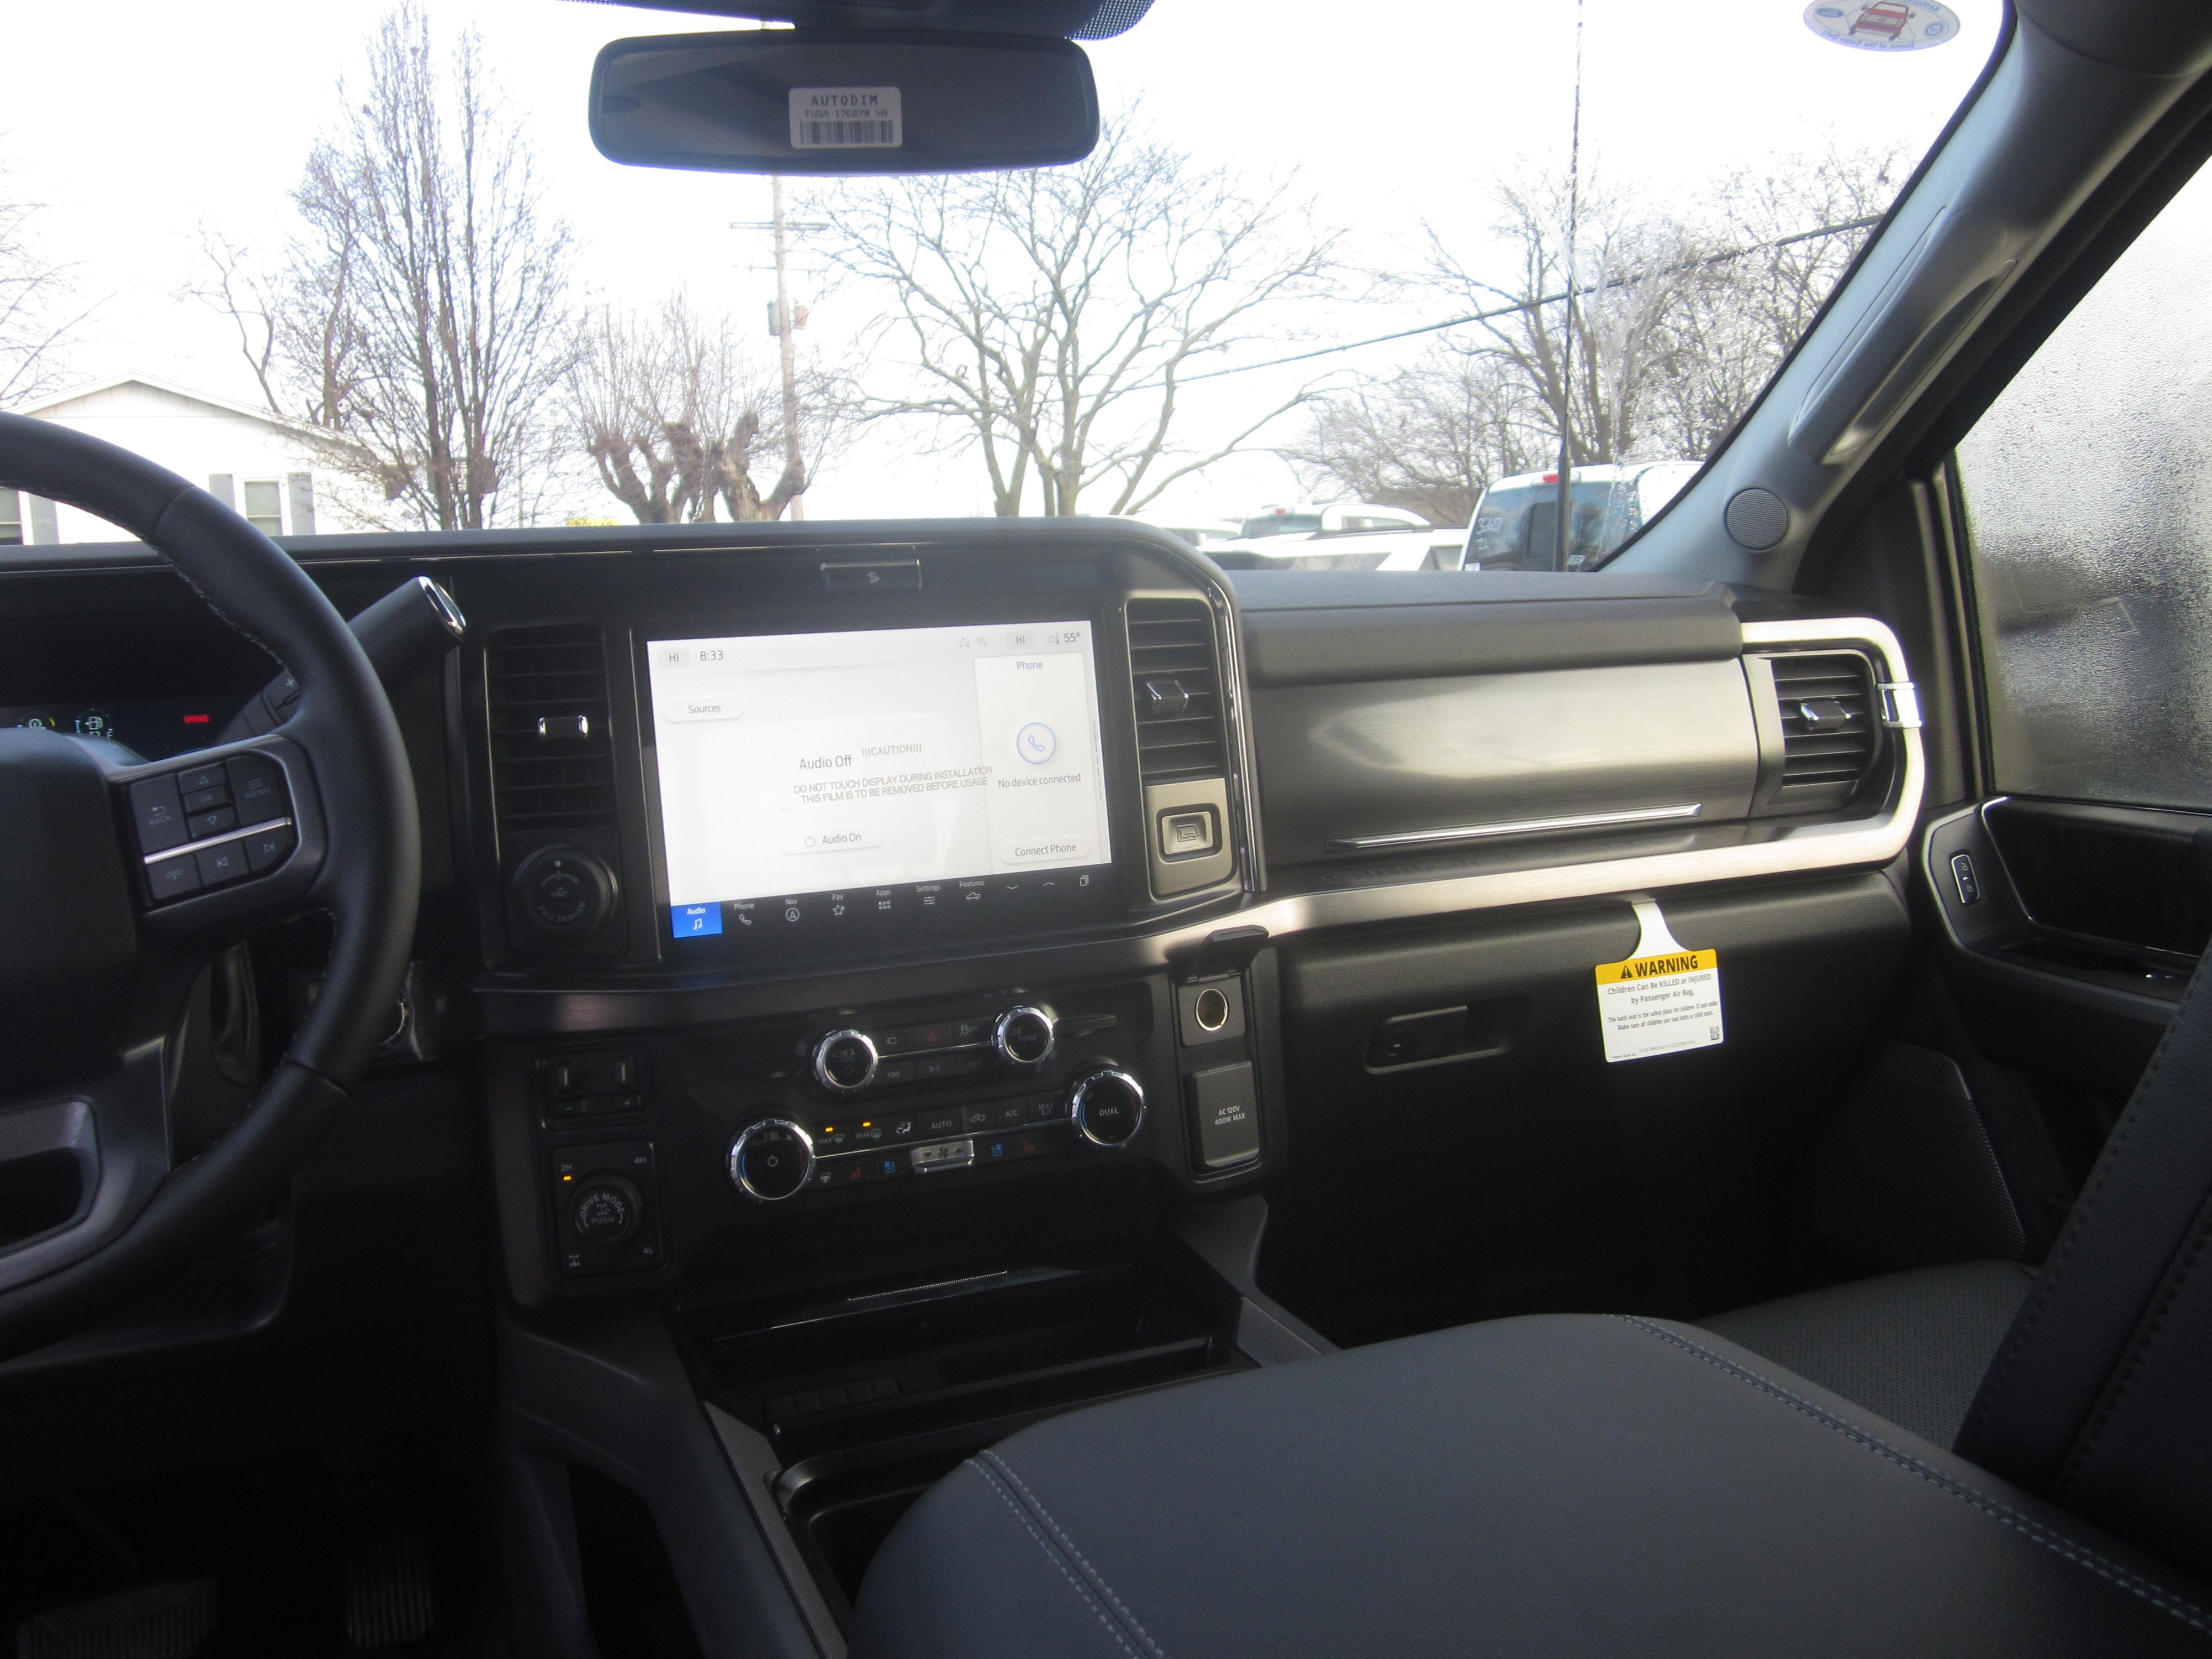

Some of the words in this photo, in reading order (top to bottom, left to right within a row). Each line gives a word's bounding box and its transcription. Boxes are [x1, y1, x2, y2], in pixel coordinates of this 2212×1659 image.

[811, 95, 878, 106] AUTODIM
[1015, 635, 1025, 644] HI
[1063, 632, 1081, 643] 55°
[669, 653, 680, 662] HI
[699, 650, 724, 661] 8:33
[1016, 660, 1043, 671] Phone
[688, 703, 722, 714] Sources
[799, 756, 833, 770] Audio
[834, 754, 853, 767] Off
[794, 784, 807, 794] DO
[808, 782, 828, 793] NOT
[829, 779, 860, 791] TOUCH
[861, 775, 898, 788] DISPLAY
[899, 771, 933, 784] DURING
[933, 765, 993, 780] INSTALLATION
[998, 779, 1010, 789] No
[1011, 776, 1038, 787] device
[1039, 773, 1082, 785] connected
[801, 794, 822, 804] THIS
[822, 791, 844, 802] FILM
[845, 790, 854, 800] IS
[855, 789, 868, 799] TO
[869, 787, 881, 797] BE
[881, 783, 925, 796] REMOVED
[926, 780, 959, 792] BEFORE
[822, 834, 848, 845] Audio
[848, 832, 862, 843] On
[1014, 846, 1049, 857] Connect
[1050, 842, 1077, 854] Phone
[686, 906, 706, 915] Audio
[733, 902, 755, 911] Phone
[875, 889, 891, 897] Apps
[916, 884, 941, 893] Settings
[959, 879, 985, 888] Features
[1635, 954, 1699, 978] WARNING
[1607, 983, 1636, 995] Children
[1636, 983, 1650, 992] Can
[1659, 978, 1680, 988] KILLED
[1688, 973, 1712, 984] INJURED
[1630, 997, 1639, 1005] by
[1640, 992, 1672, 1003] Passenger
[1682, 989, 1695, 997] Bag.
[1647, 1019, 1663, 1027] children
[1018, 1034, 1038, 1042] TUNE
[1005, 1109, 1019, 1118] A/C
[1099, 1106, 1120, 1117] DUAL
[1218, 1108, 1227, 1116] AC
[1226, 1105, 1241, 1114] 120V
[931, 1120, 953, 1129] AUTO
[1214, 1115, 1232, 1126] 400W
[1232, 1112, 1246, 1121] MAX
[560, 1164, 572, 1172] 2H
[580, 1193, 601, 1218] DRIVE
[601, 1192, 625, 1214] MODE
[591, 1216, 615, 1224] PUSH
[643, 1246, 654, 1254] 4L
